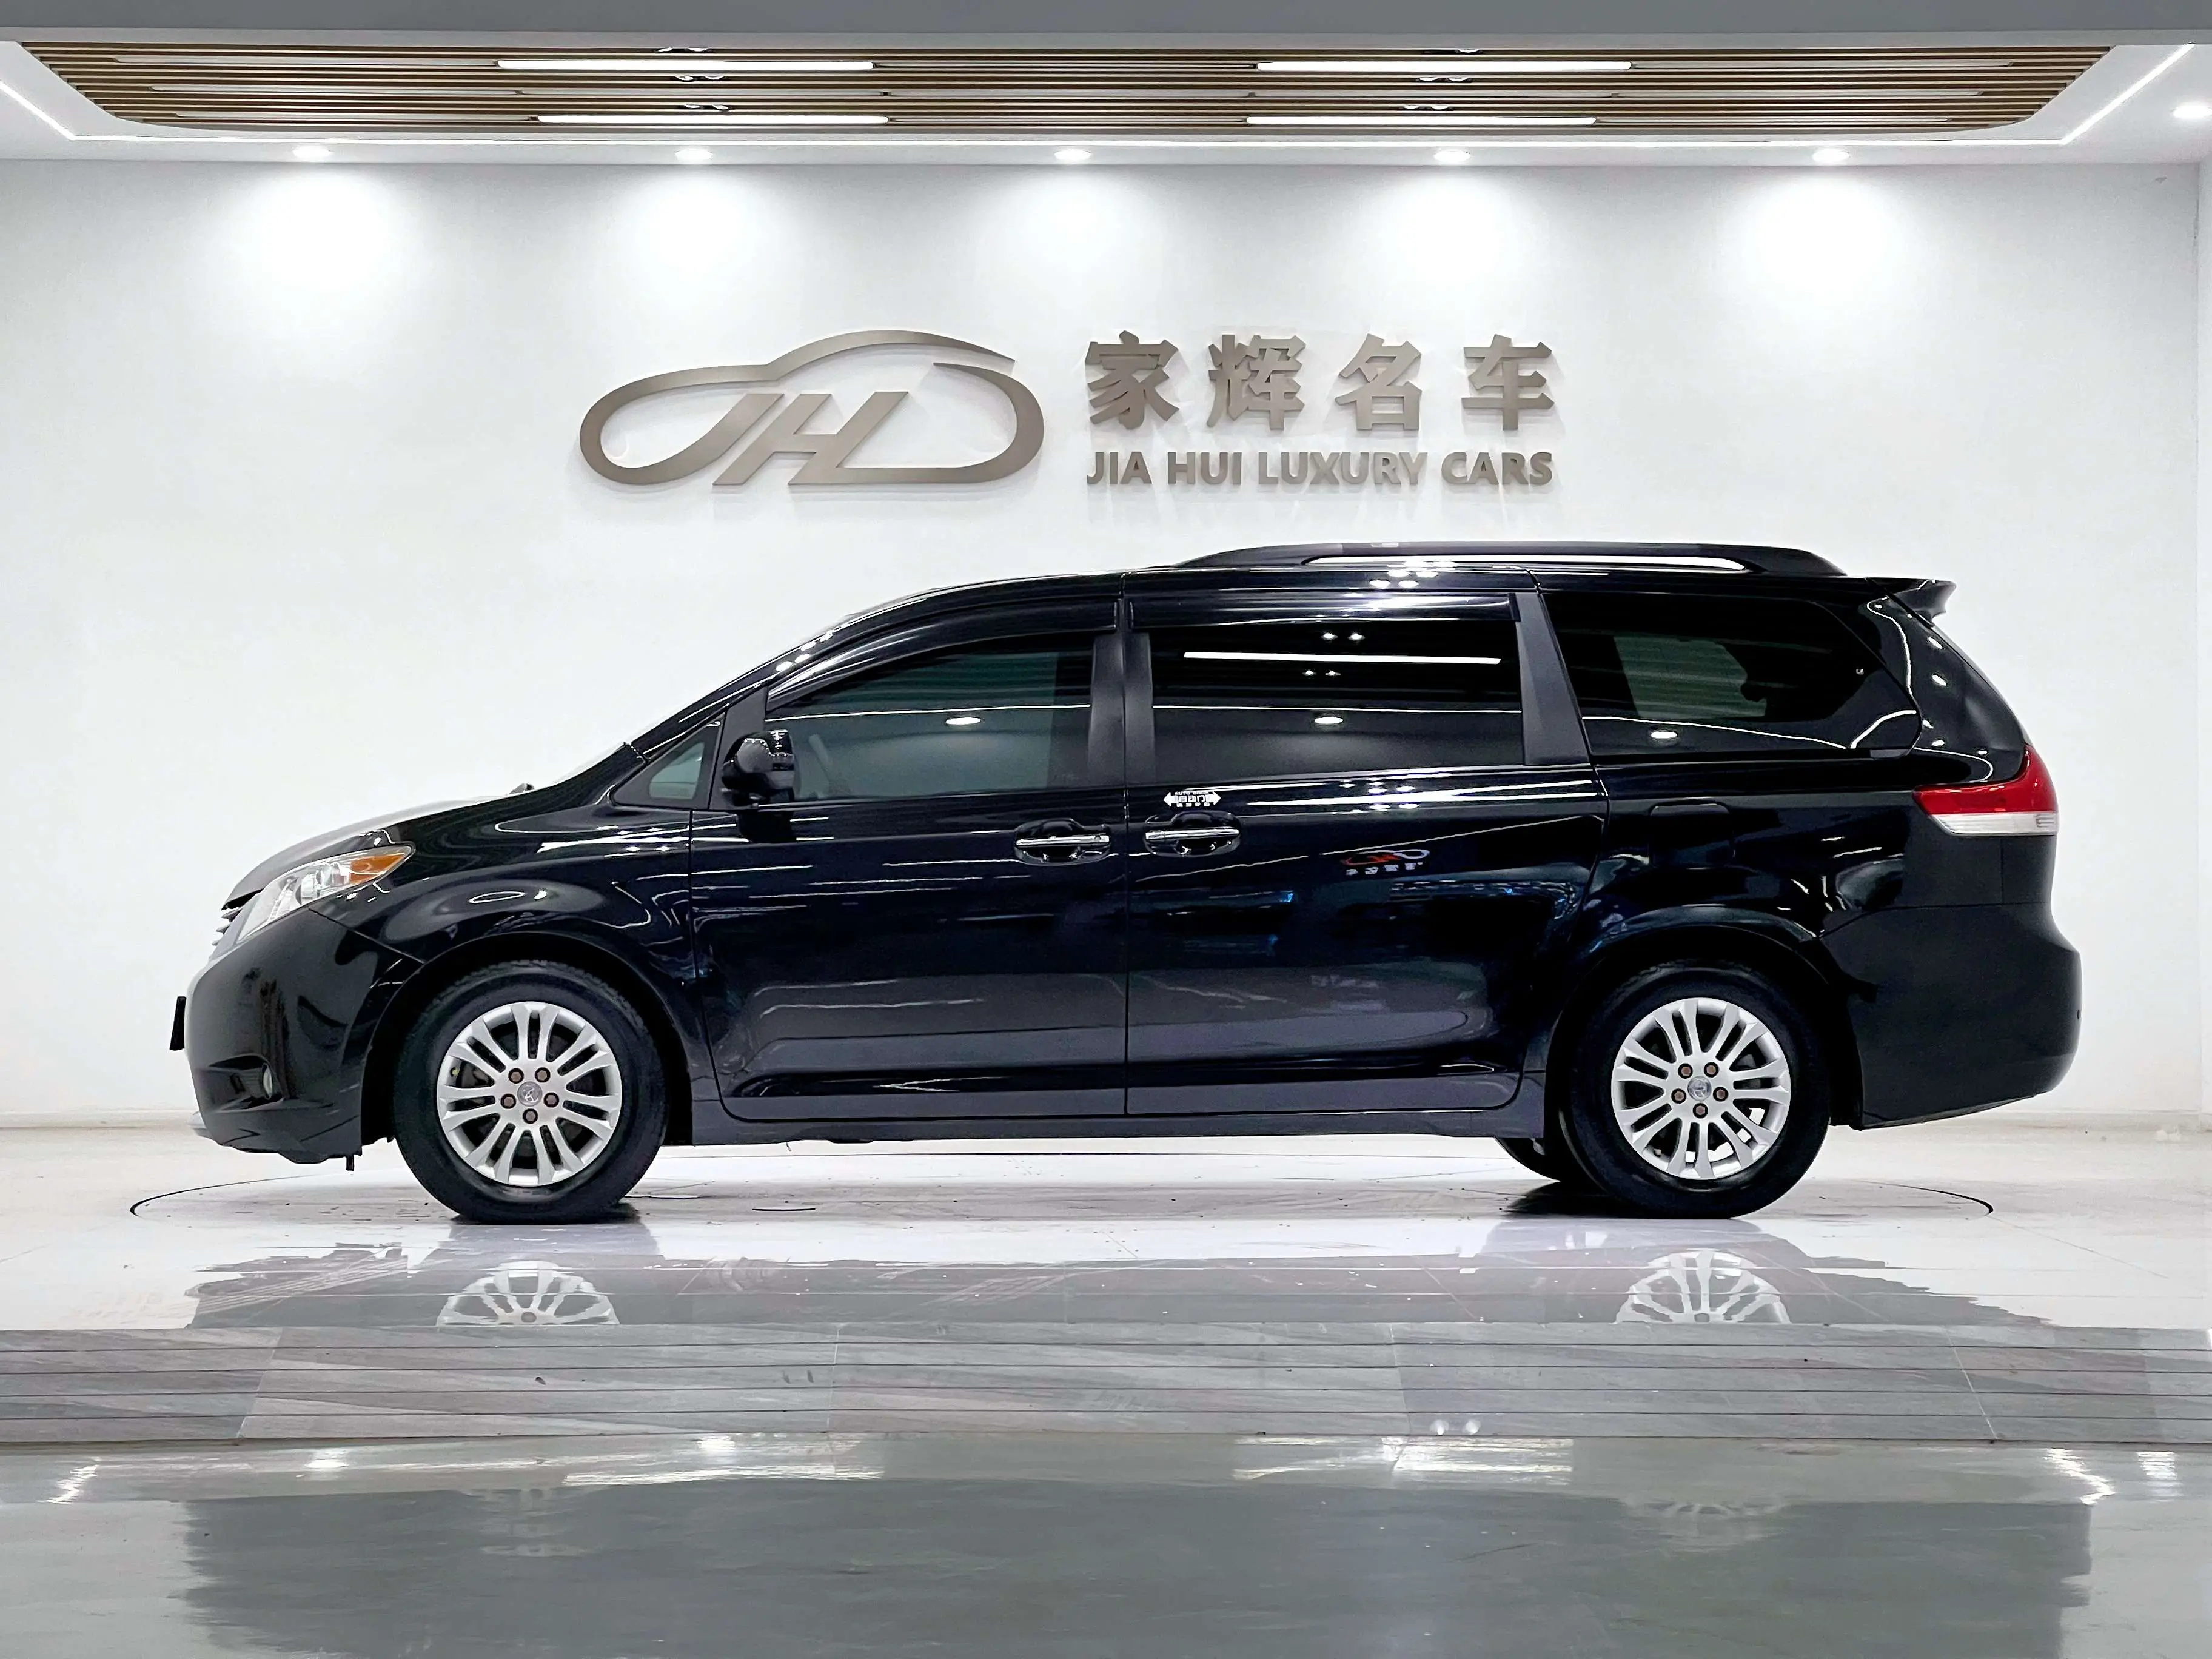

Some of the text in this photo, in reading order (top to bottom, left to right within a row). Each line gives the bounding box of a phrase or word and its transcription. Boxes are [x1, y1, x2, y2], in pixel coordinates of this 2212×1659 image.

[1084, 330, 1556, 437] 家辉名车
[1087, 451, 1553, 490] JIA HUI LUXURY CARS
